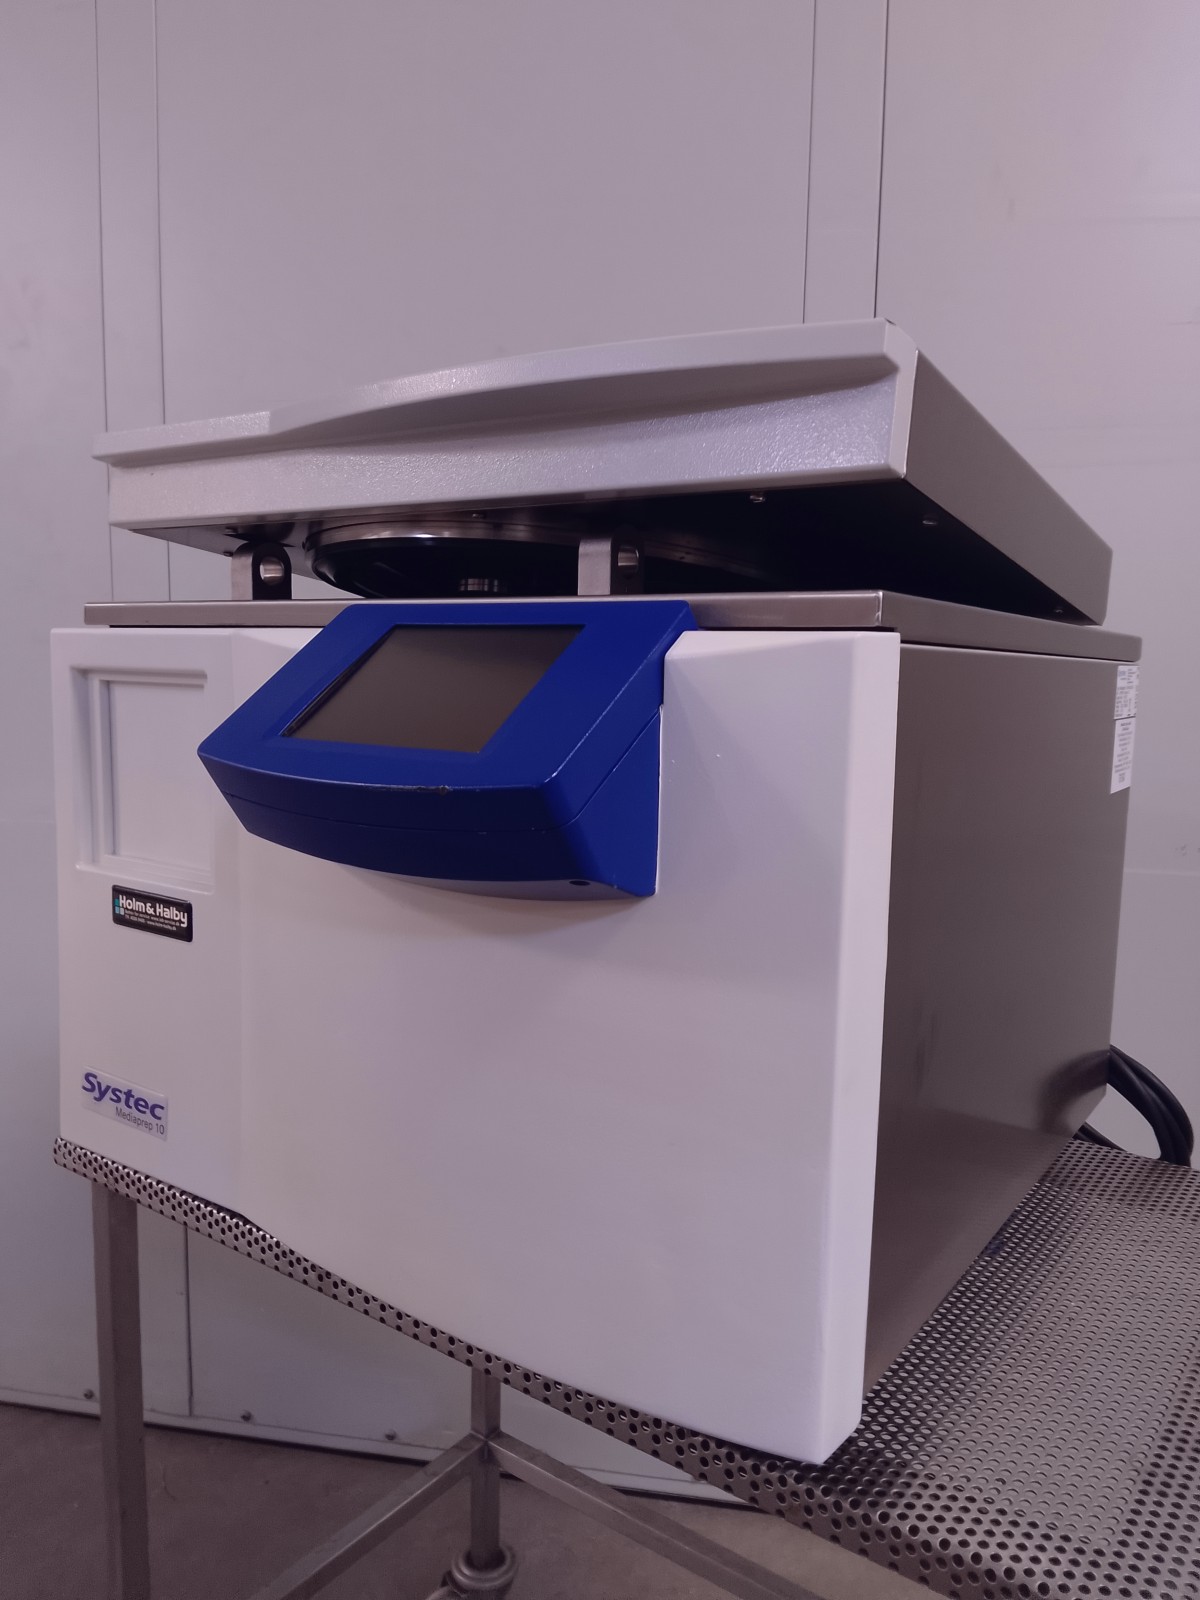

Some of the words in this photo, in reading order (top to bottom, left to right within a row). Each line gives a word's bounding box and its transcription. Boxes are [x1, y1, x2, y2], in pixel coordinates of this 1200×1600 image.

[119, 894, 145, 913] Holm
[146, 902, 155, 915] &
[156, 903, 188, 928] Halby
[81, 1072, 165, 1121] Systec
[115, 1106, 153, 1132] Mediaprep
[155, 1123, 165, 1135] 10
